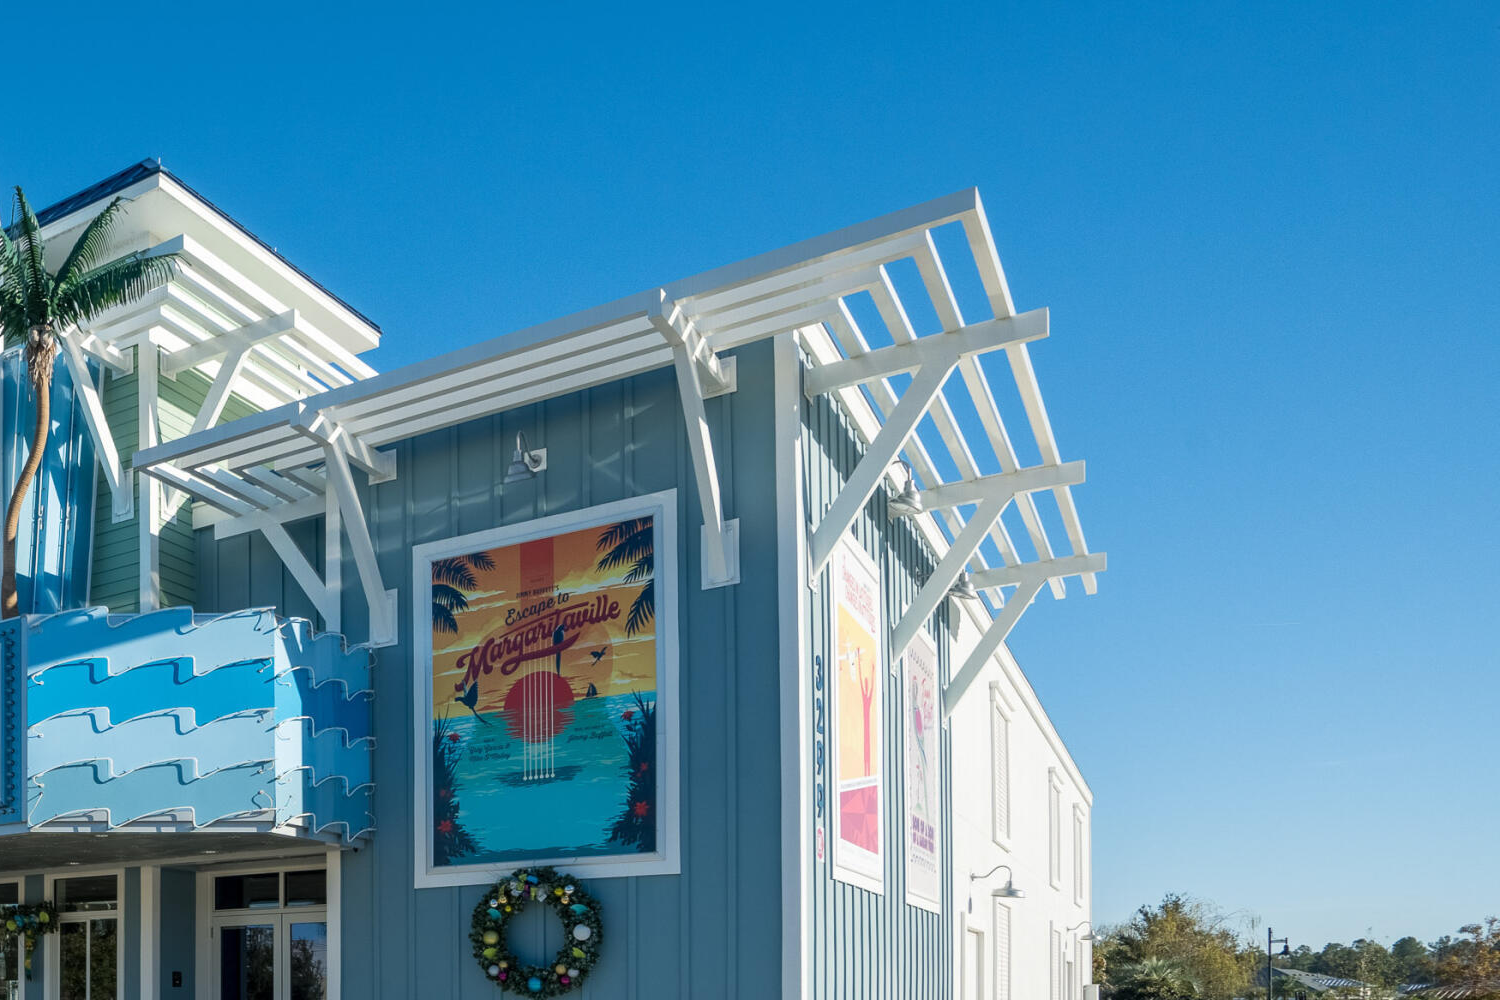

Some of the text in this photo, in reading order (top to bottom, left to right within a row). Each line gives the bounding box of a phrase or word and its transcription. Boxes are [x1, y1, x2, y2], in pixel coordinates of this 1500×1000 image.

[454, 594, 621, 692] Margaritaville
[505, 591, 572, 626] Escape to
[815, 655, 824, 818] 3299
